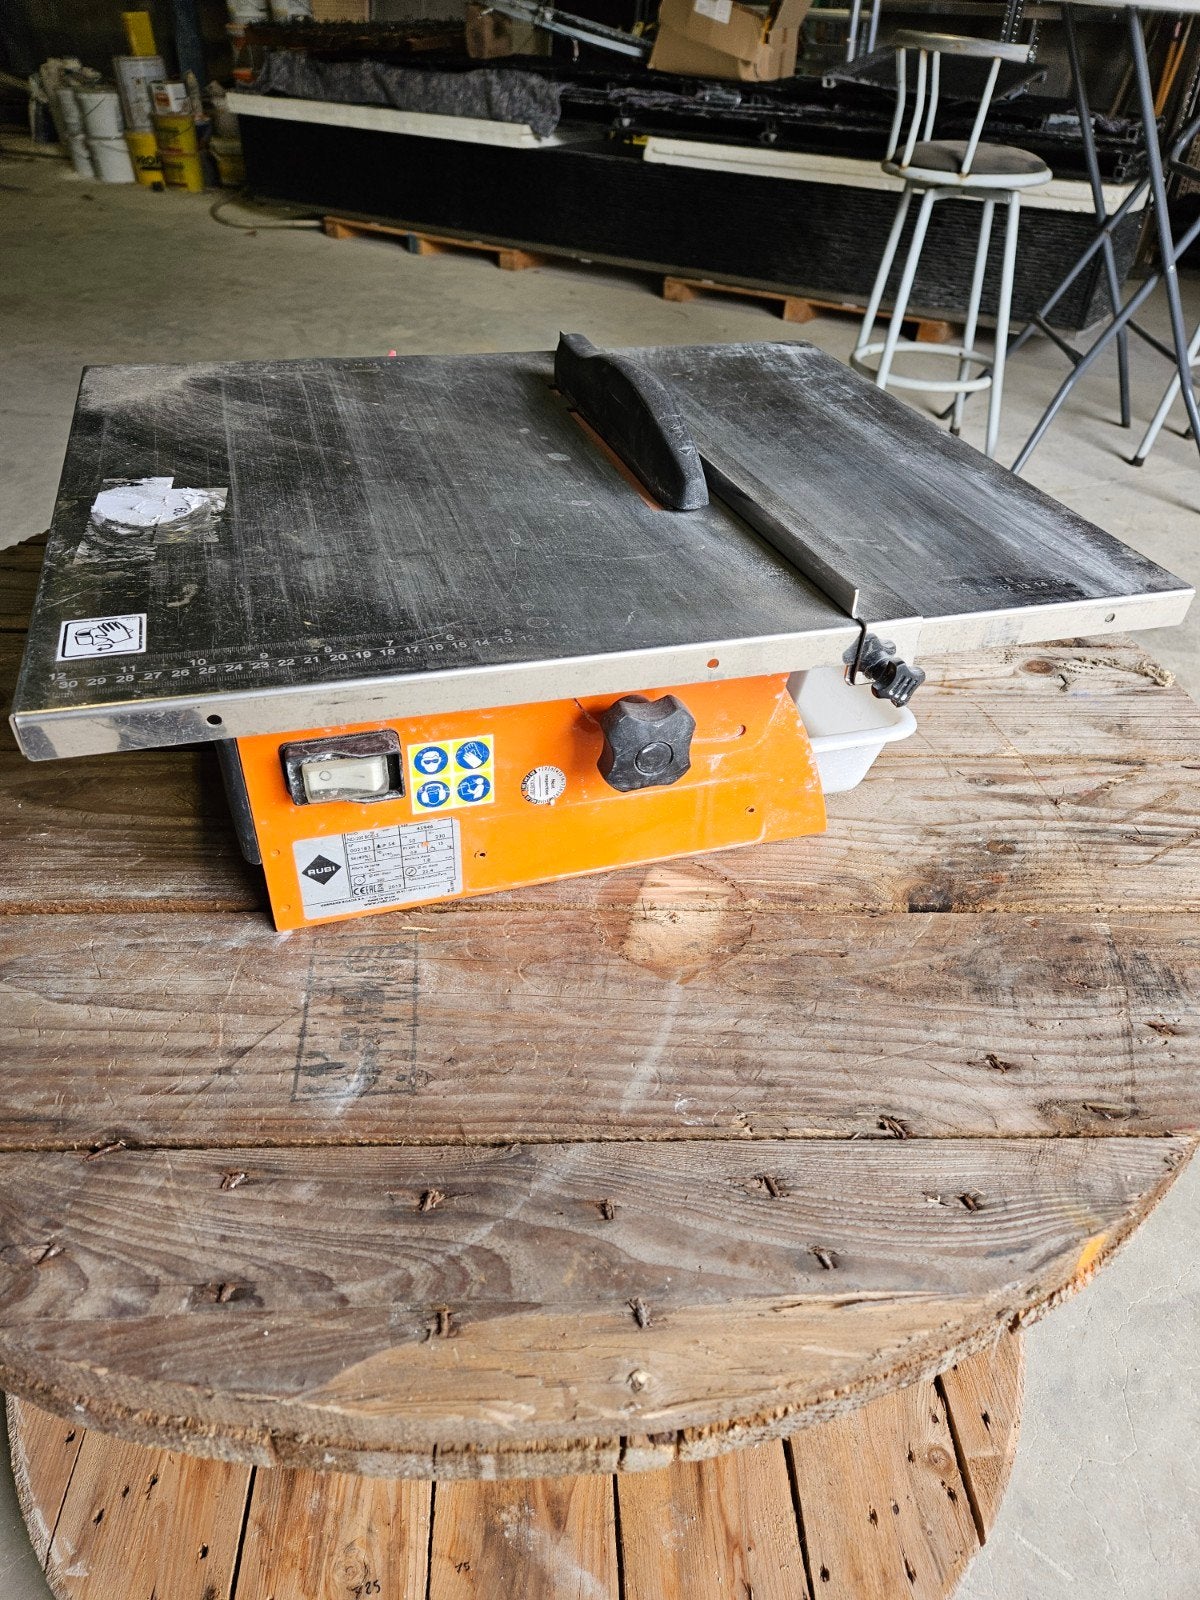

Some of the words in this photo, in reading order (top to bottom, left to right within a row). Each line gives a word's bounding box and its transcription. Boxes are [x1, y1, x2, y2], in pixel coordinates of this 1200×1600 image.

[58, 680, 78, 689] 30
[116, 674, 135, 683] 28
[143, 671, 163, 680] 27
[171, 668, 190, 677] 26
[199, 666, 217, 675] 25
[225, 664, 243, 672] 24
[252, 661, 269, 670] 23
[278, 658, 295, 667] 22
[303, 656, 319, 664] 21
[330, 653, 347, 662] 20
[356, 651, 372, 659] 19
[380, 648, 396, 656] 18
[404, 646, 420, 654] 17
[475, 639, 490, 647] 14
[120, 665, 136, 673] 11
[189, 658, 207, 667] 10
[307, 865, 336, 876] RUBI
